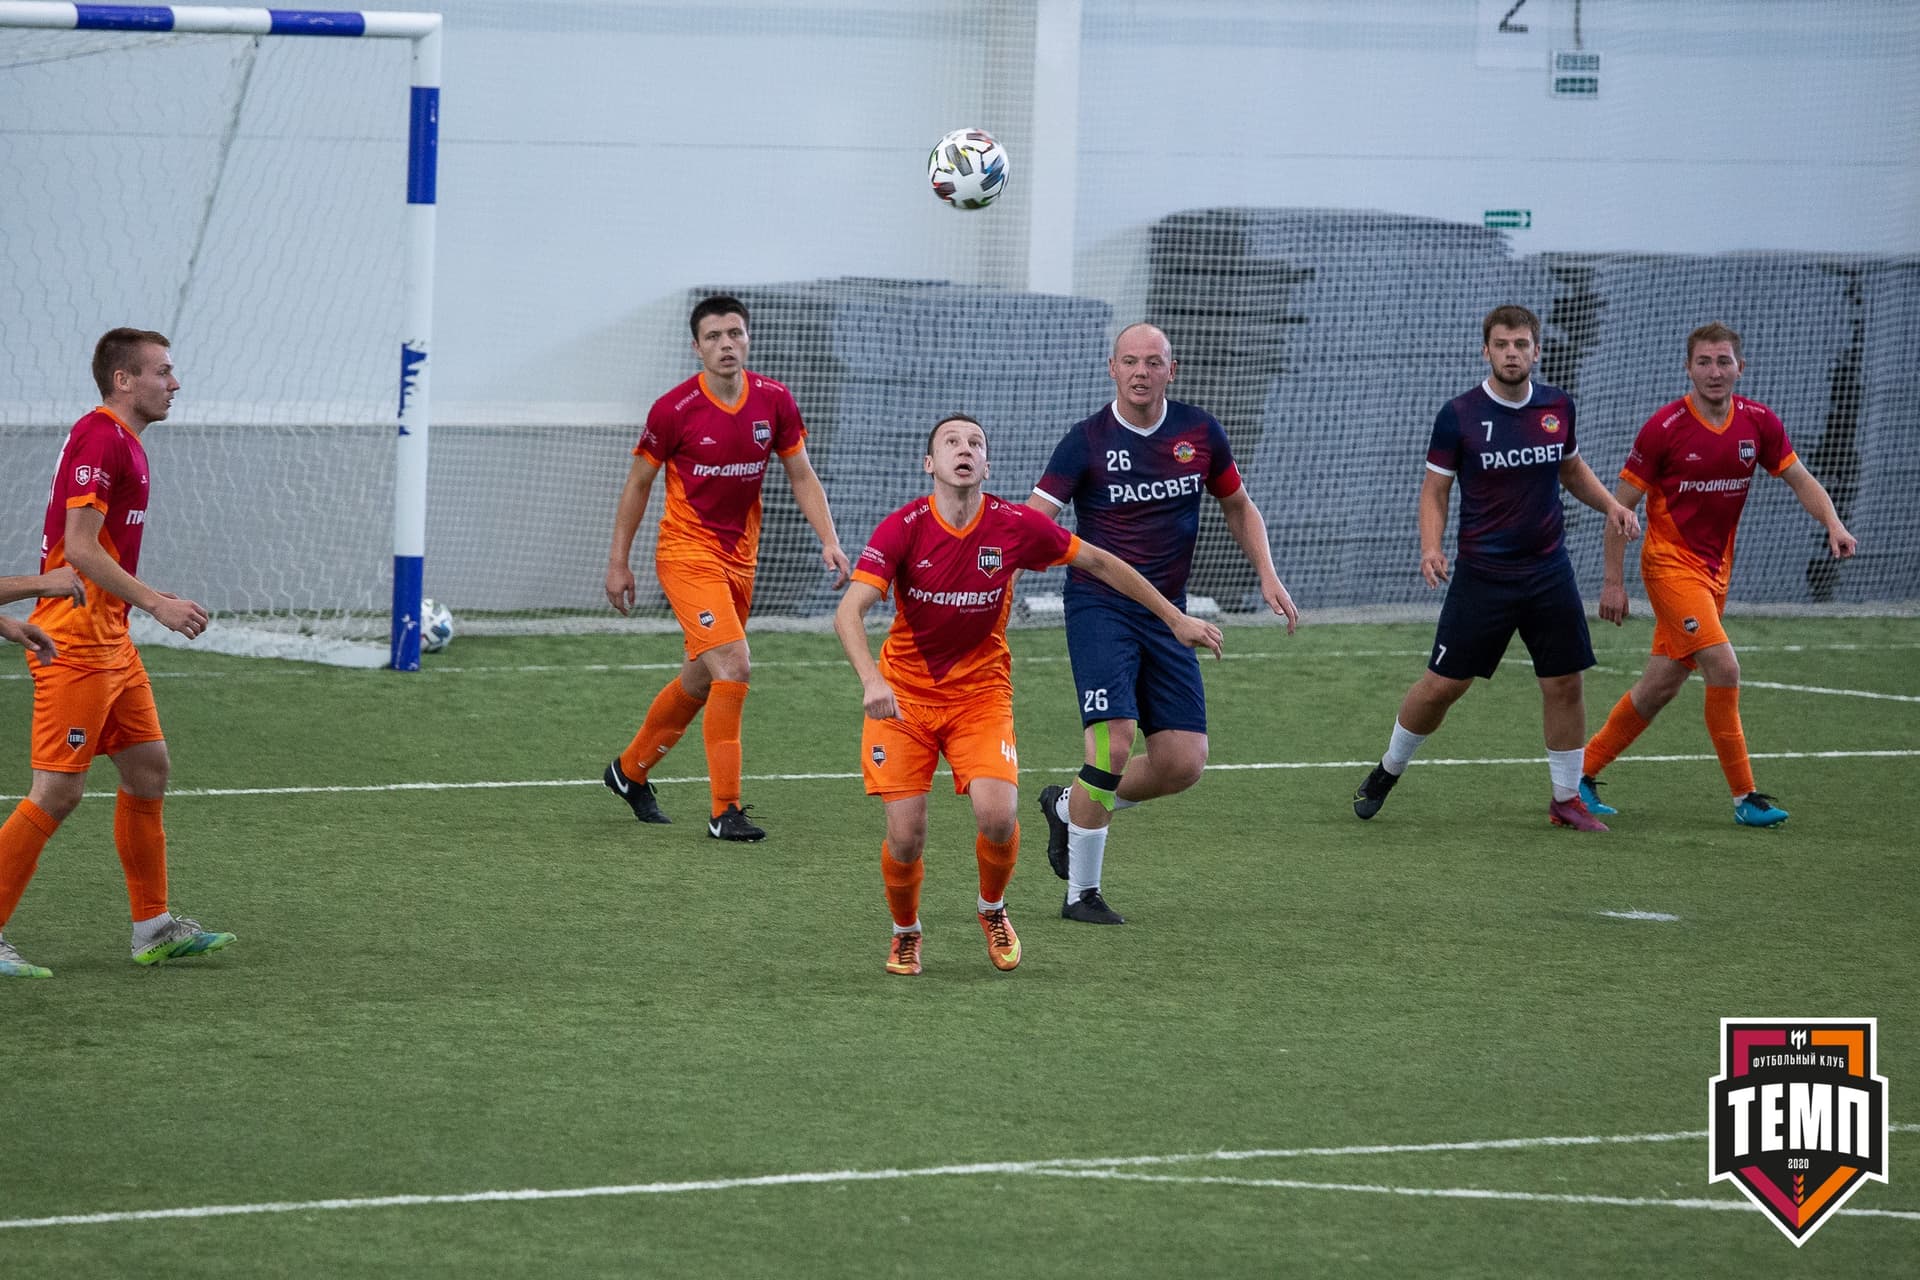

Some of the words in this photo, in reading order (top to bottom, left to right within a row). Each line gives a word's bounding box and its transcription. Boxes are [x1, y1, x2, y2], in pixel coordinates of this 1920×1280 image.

[1481, 421, 1493, 442] 7
[1106, 450, 1132, 472] 26
[1480, 443, 1564, 470] РАССВЕТ
[1108, 473, 1201, 503] РАССВЕТ
[1435, 644, 1447, 665] 7
[1083, 688, 1109, 713] 26
